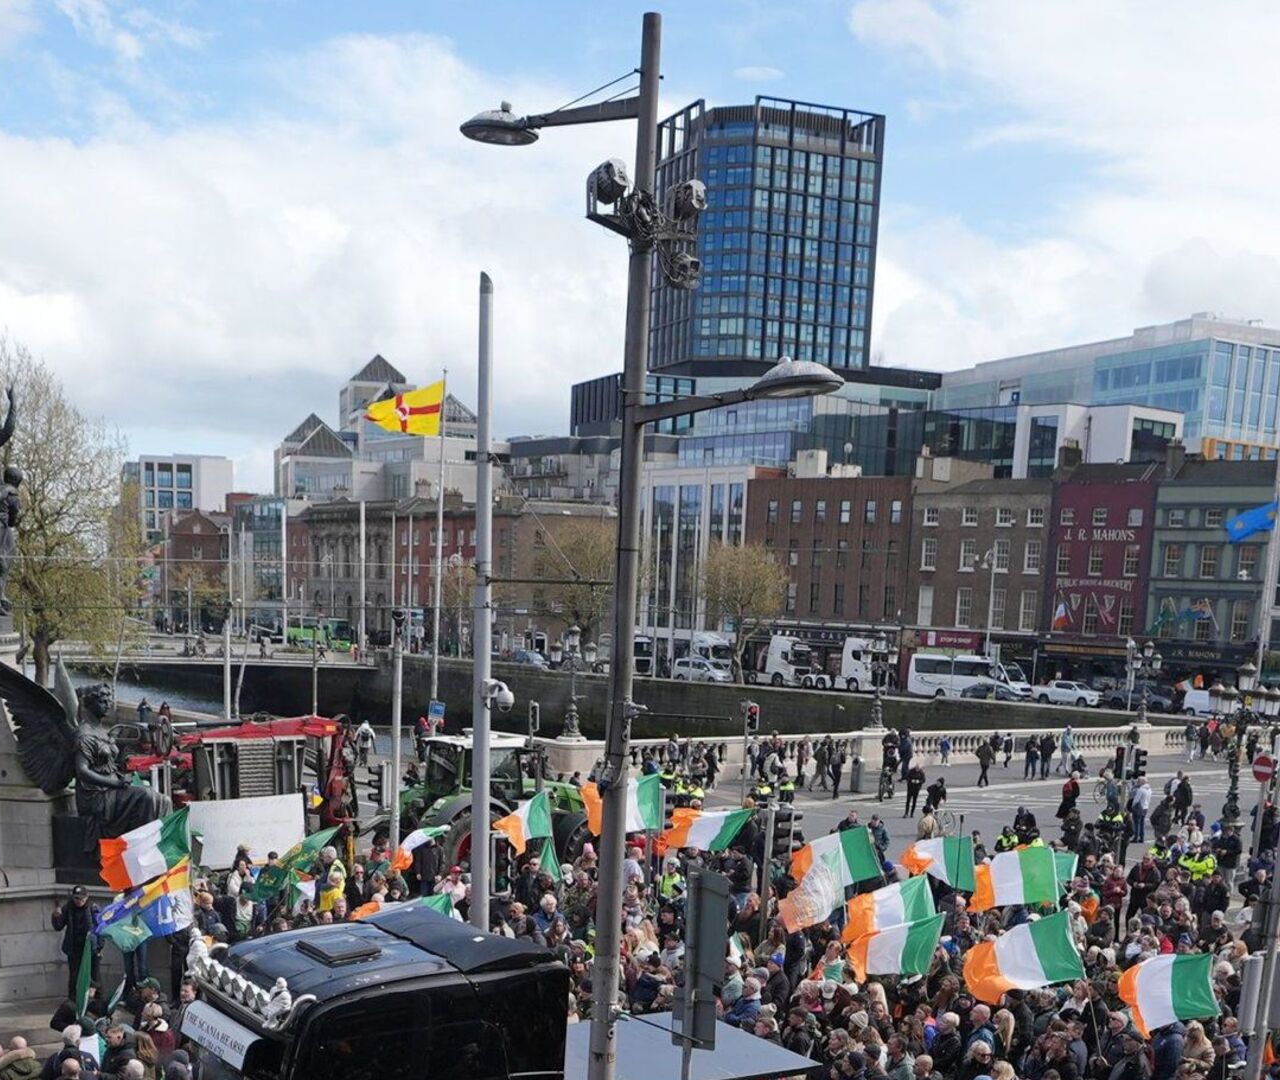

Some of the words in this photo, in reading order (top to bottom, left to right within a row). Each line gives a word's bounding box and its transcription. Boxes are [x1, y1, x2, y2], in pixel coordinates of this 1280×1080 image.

[186, 1010, 198, 1026] THE
[198, 1018, 220, 1041] SCANIA
[220, 1031, 246, 1057] HEARSE
